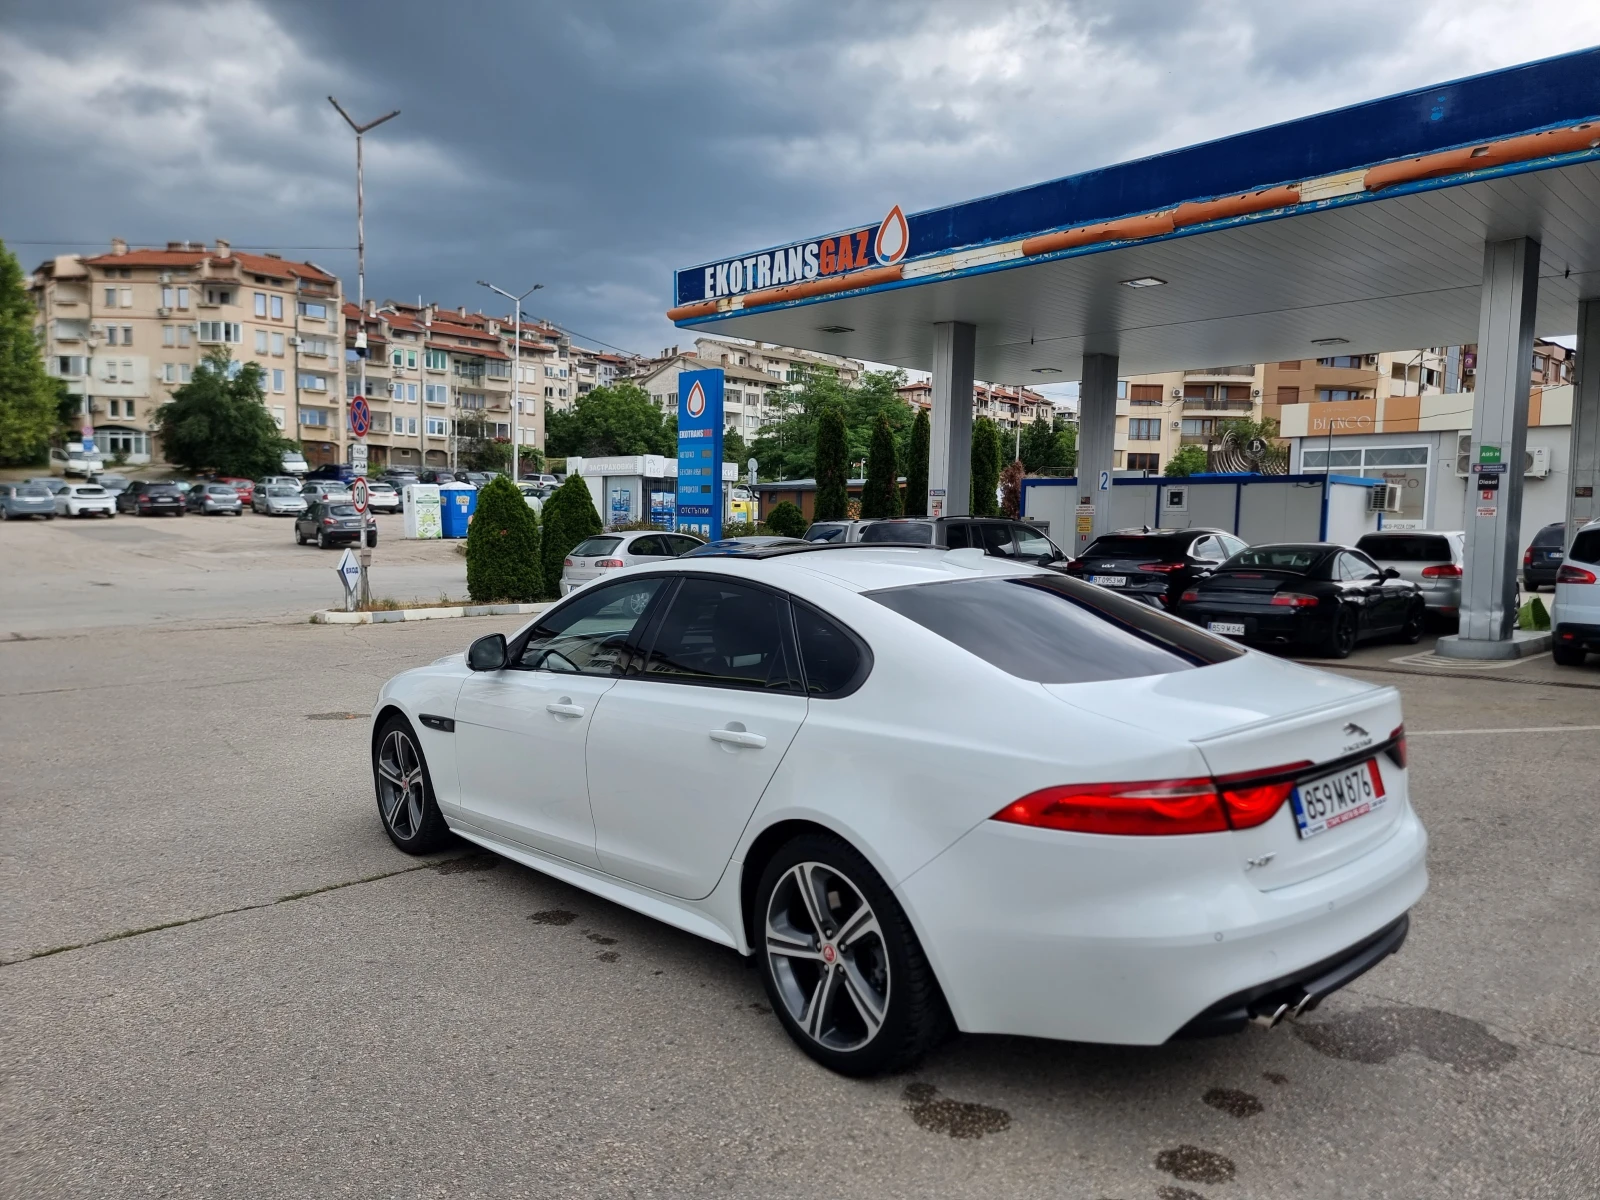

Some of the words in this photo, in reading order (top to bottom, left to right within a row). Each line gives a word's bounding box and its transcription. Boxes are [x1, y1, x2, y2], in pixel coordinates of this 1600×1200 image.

[704, 230, 870, 299] EKOTRANSGAZ
[1313, 415, 1371, 430] BIANCO
[1252, 441, 1261, 452] B
[588, 462, 634, 472] ЗАСТРАХОВКИ
[1100, 471, 1108, 490] 2
[355, 486, 365, 504] 30
[680, 507, 709, 515] ОТСТЪПКИ
[345, 567, 359, 575] ВХОД
